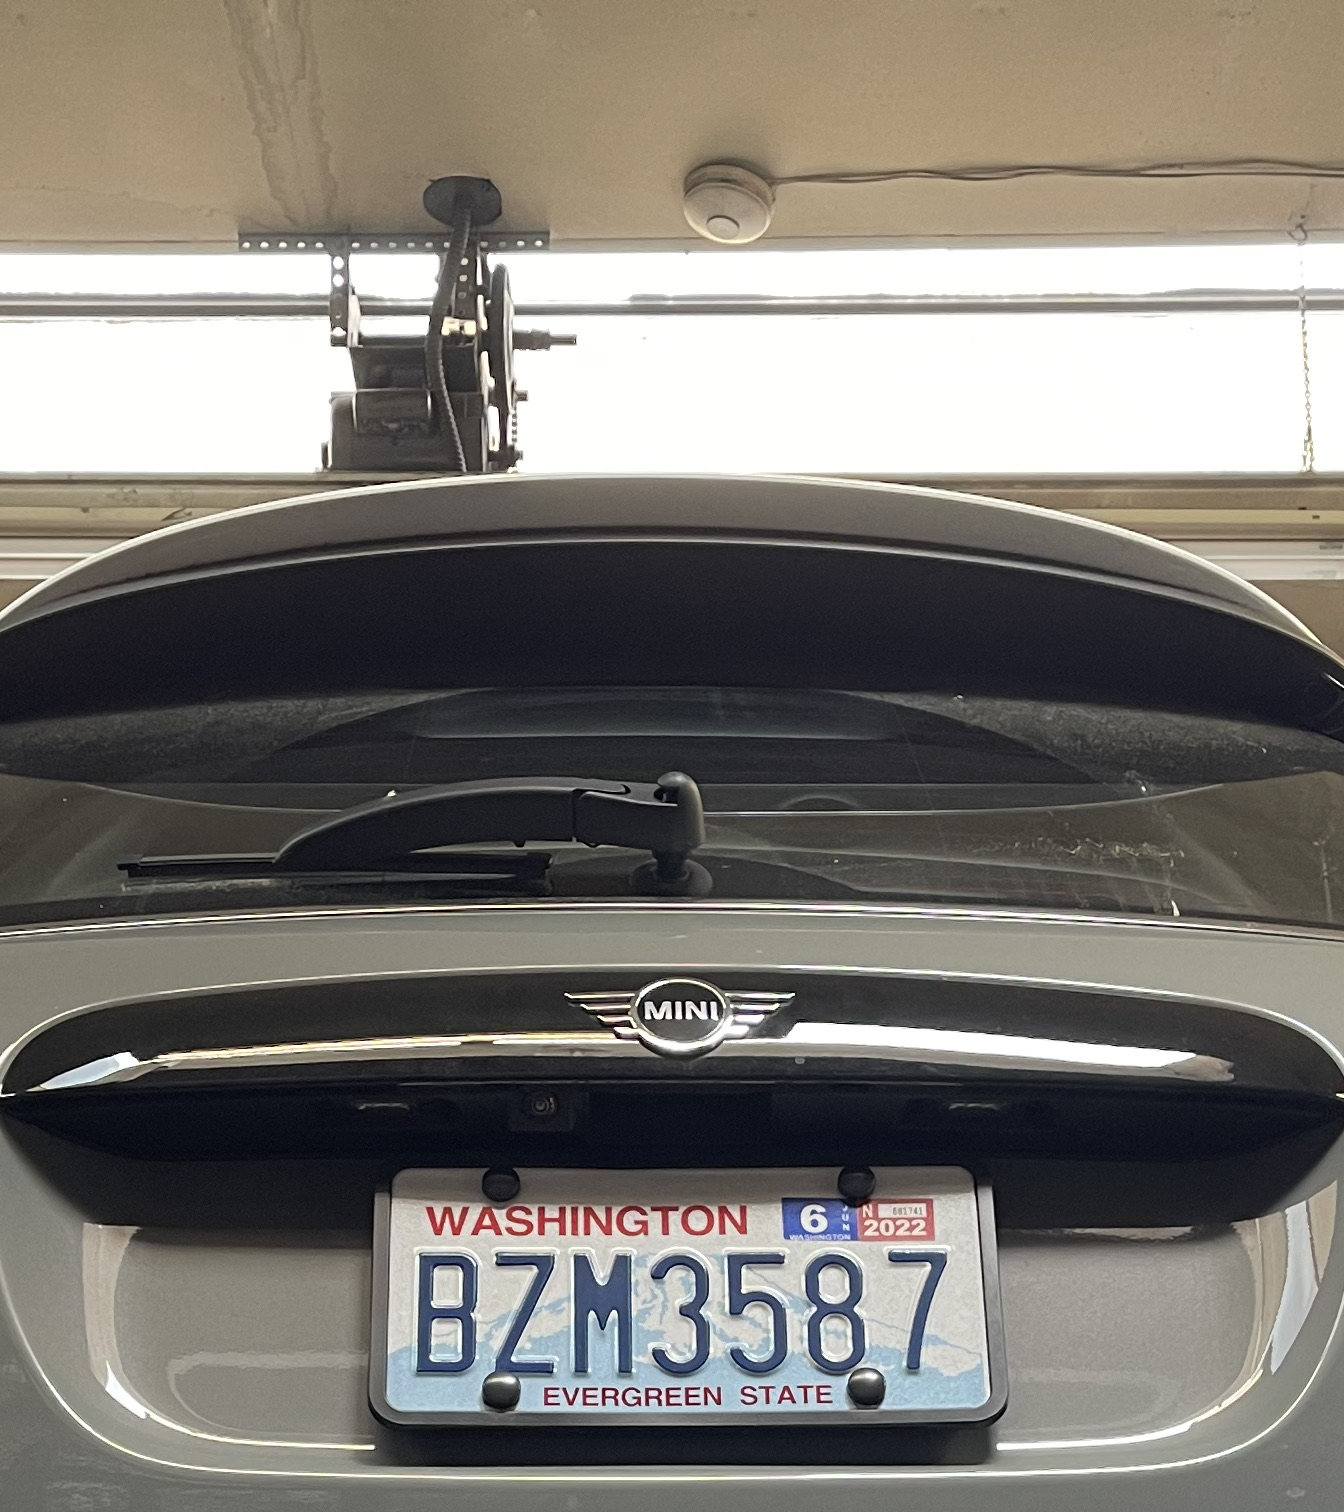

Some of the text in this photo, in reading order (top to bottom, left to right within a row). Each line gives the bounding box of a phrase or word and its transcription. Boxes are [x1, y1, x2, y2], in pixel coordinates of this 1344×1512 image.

[644, 1000, 719, 1021] MINI
[425, 1204, 748, 1237] WASHINGTON
[799, 1203, 829, 1234] 6
[863, 1219, 927, 1237] 2022
[789, 1233, 852, 1241] WASHINGTON
[416, 1250, 949, 1376] BZM3587
[542, 1384, 834, 1407] EVERGREEN STATE
